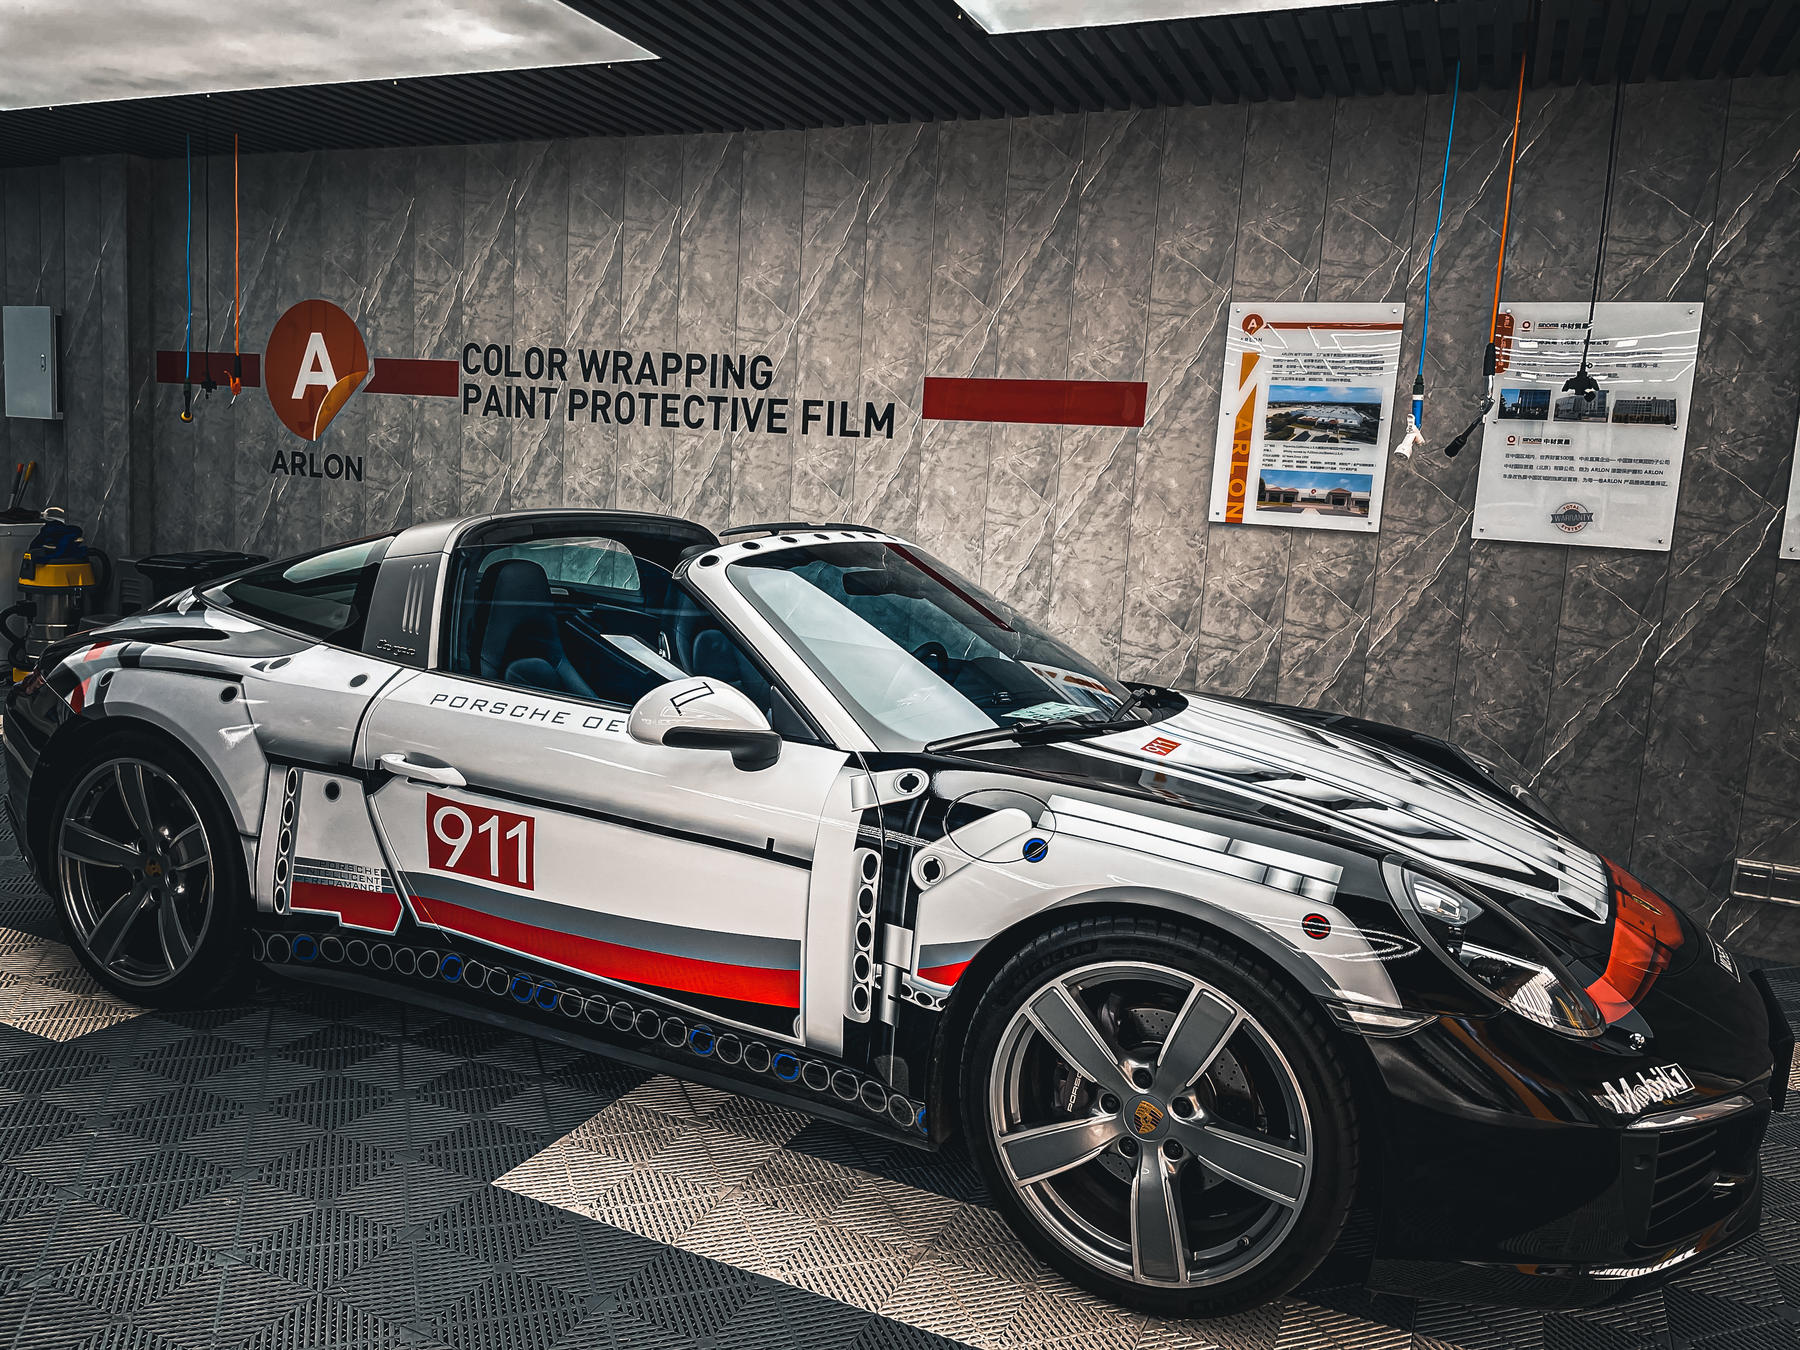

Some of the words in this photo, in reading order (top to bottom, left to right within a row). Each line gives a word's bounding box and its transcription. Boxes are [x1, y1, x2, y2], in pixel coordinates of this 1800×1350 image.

[1247, 319, 1258, 330] A
[291, 332, 338, 399] A
[462, 342, 568, 381] COLOR
[579, 348, 773, 391] WRAPPING
[462, 383, 558, 421] PAINT
[568, 388, 788, 435] PROTECTIVE
[801, 399, 896, 440] FILM
[270, 450, 363, 482] ARLON
[1226, 418, 1253, 519] ARLON
[1554, 513, 1591, 522] WARRANTY
[430, 693, 571, 725] PORSCHE
[582, 716, 628, 733] OE
[1145, 739, 1177, 754] 911
[433, 805, 528, 884] 911
[319, 861, 381, 876] PORSCHE
[1600, 1066, 1679, 1114] Mobil
